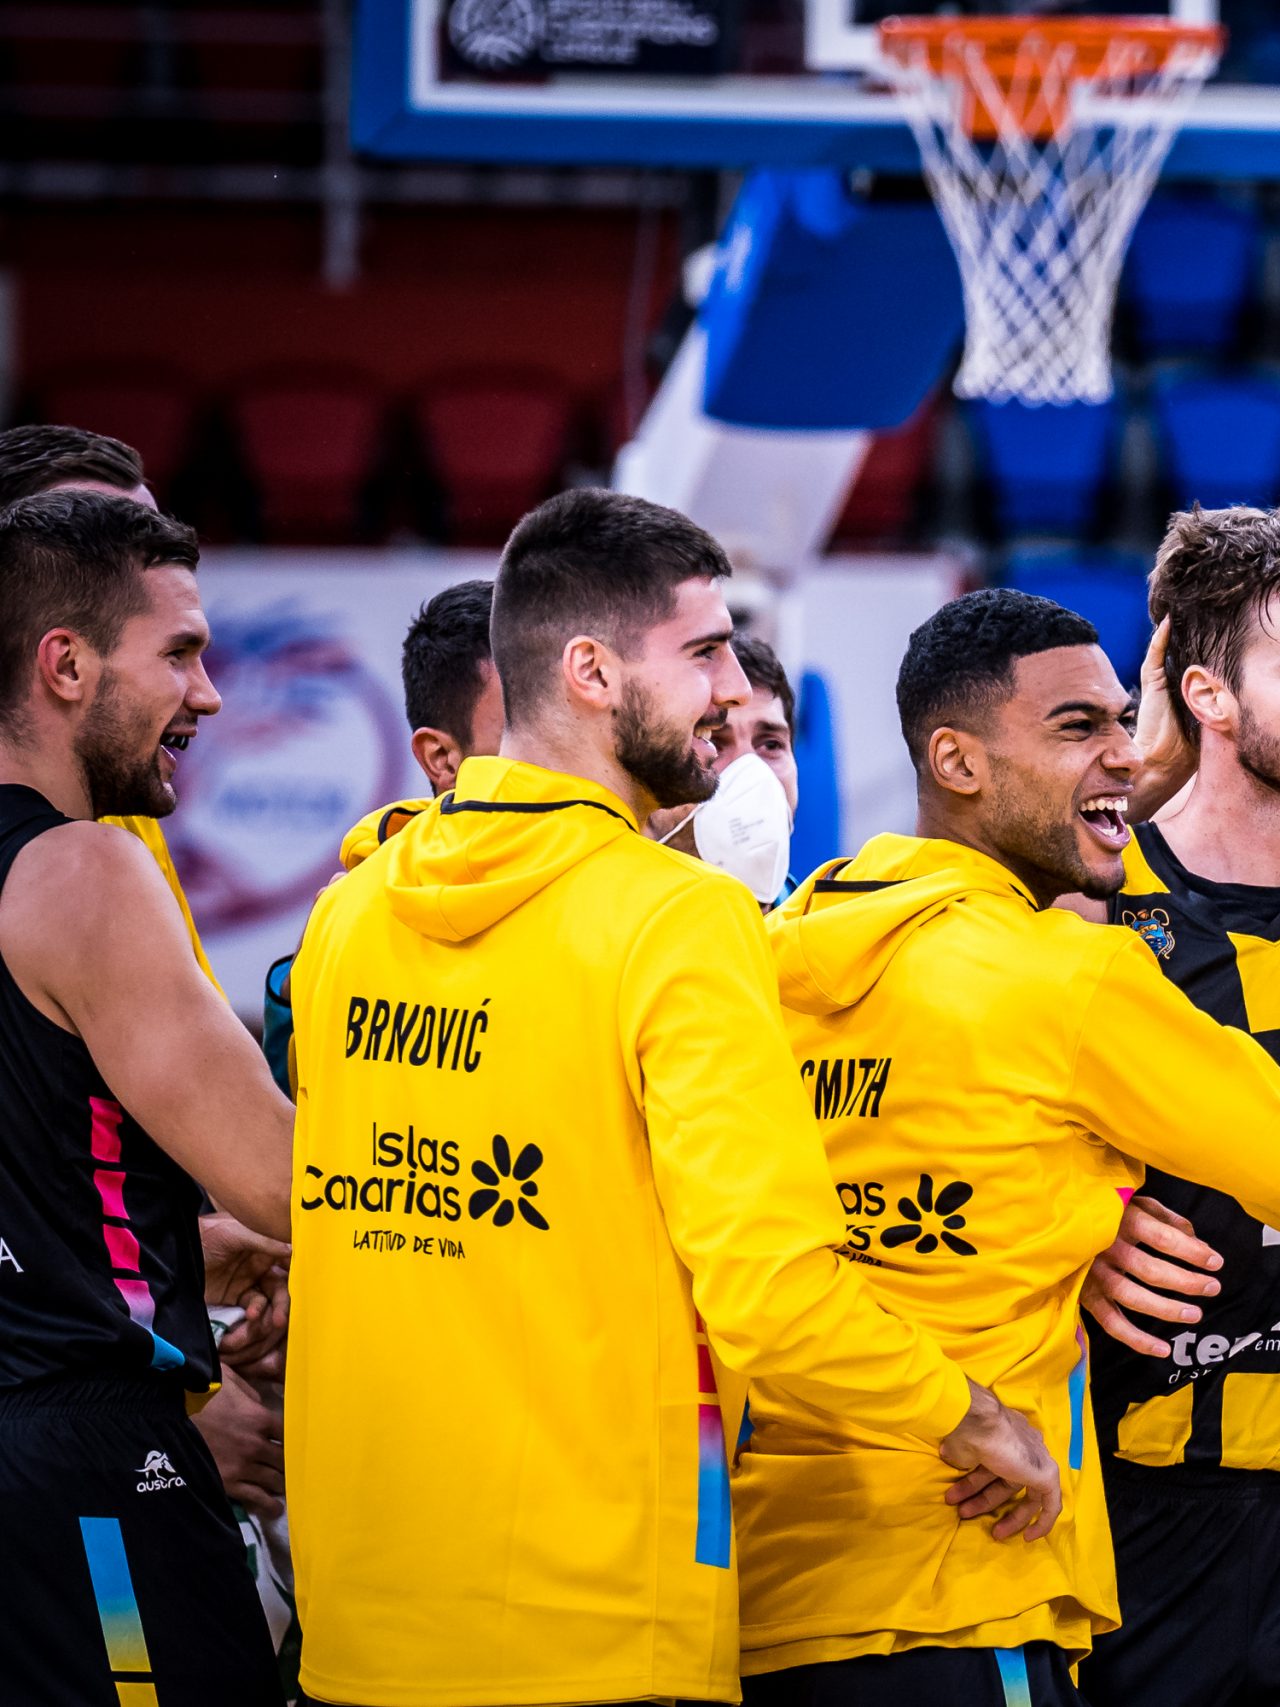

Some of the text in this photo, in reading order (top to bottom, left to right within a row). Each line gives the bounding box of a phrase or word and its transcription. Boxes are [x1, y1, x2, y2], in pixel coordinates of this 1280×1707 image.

[345, 996, 492, 1073] BRNOVIĆ
[372, 1121, 460, 1176] Islas
[301, 1164, 462, 1222] Canarias
[413, 1235, 434, 1256] DE
[438, 1237, 466, 1260] VIDA
